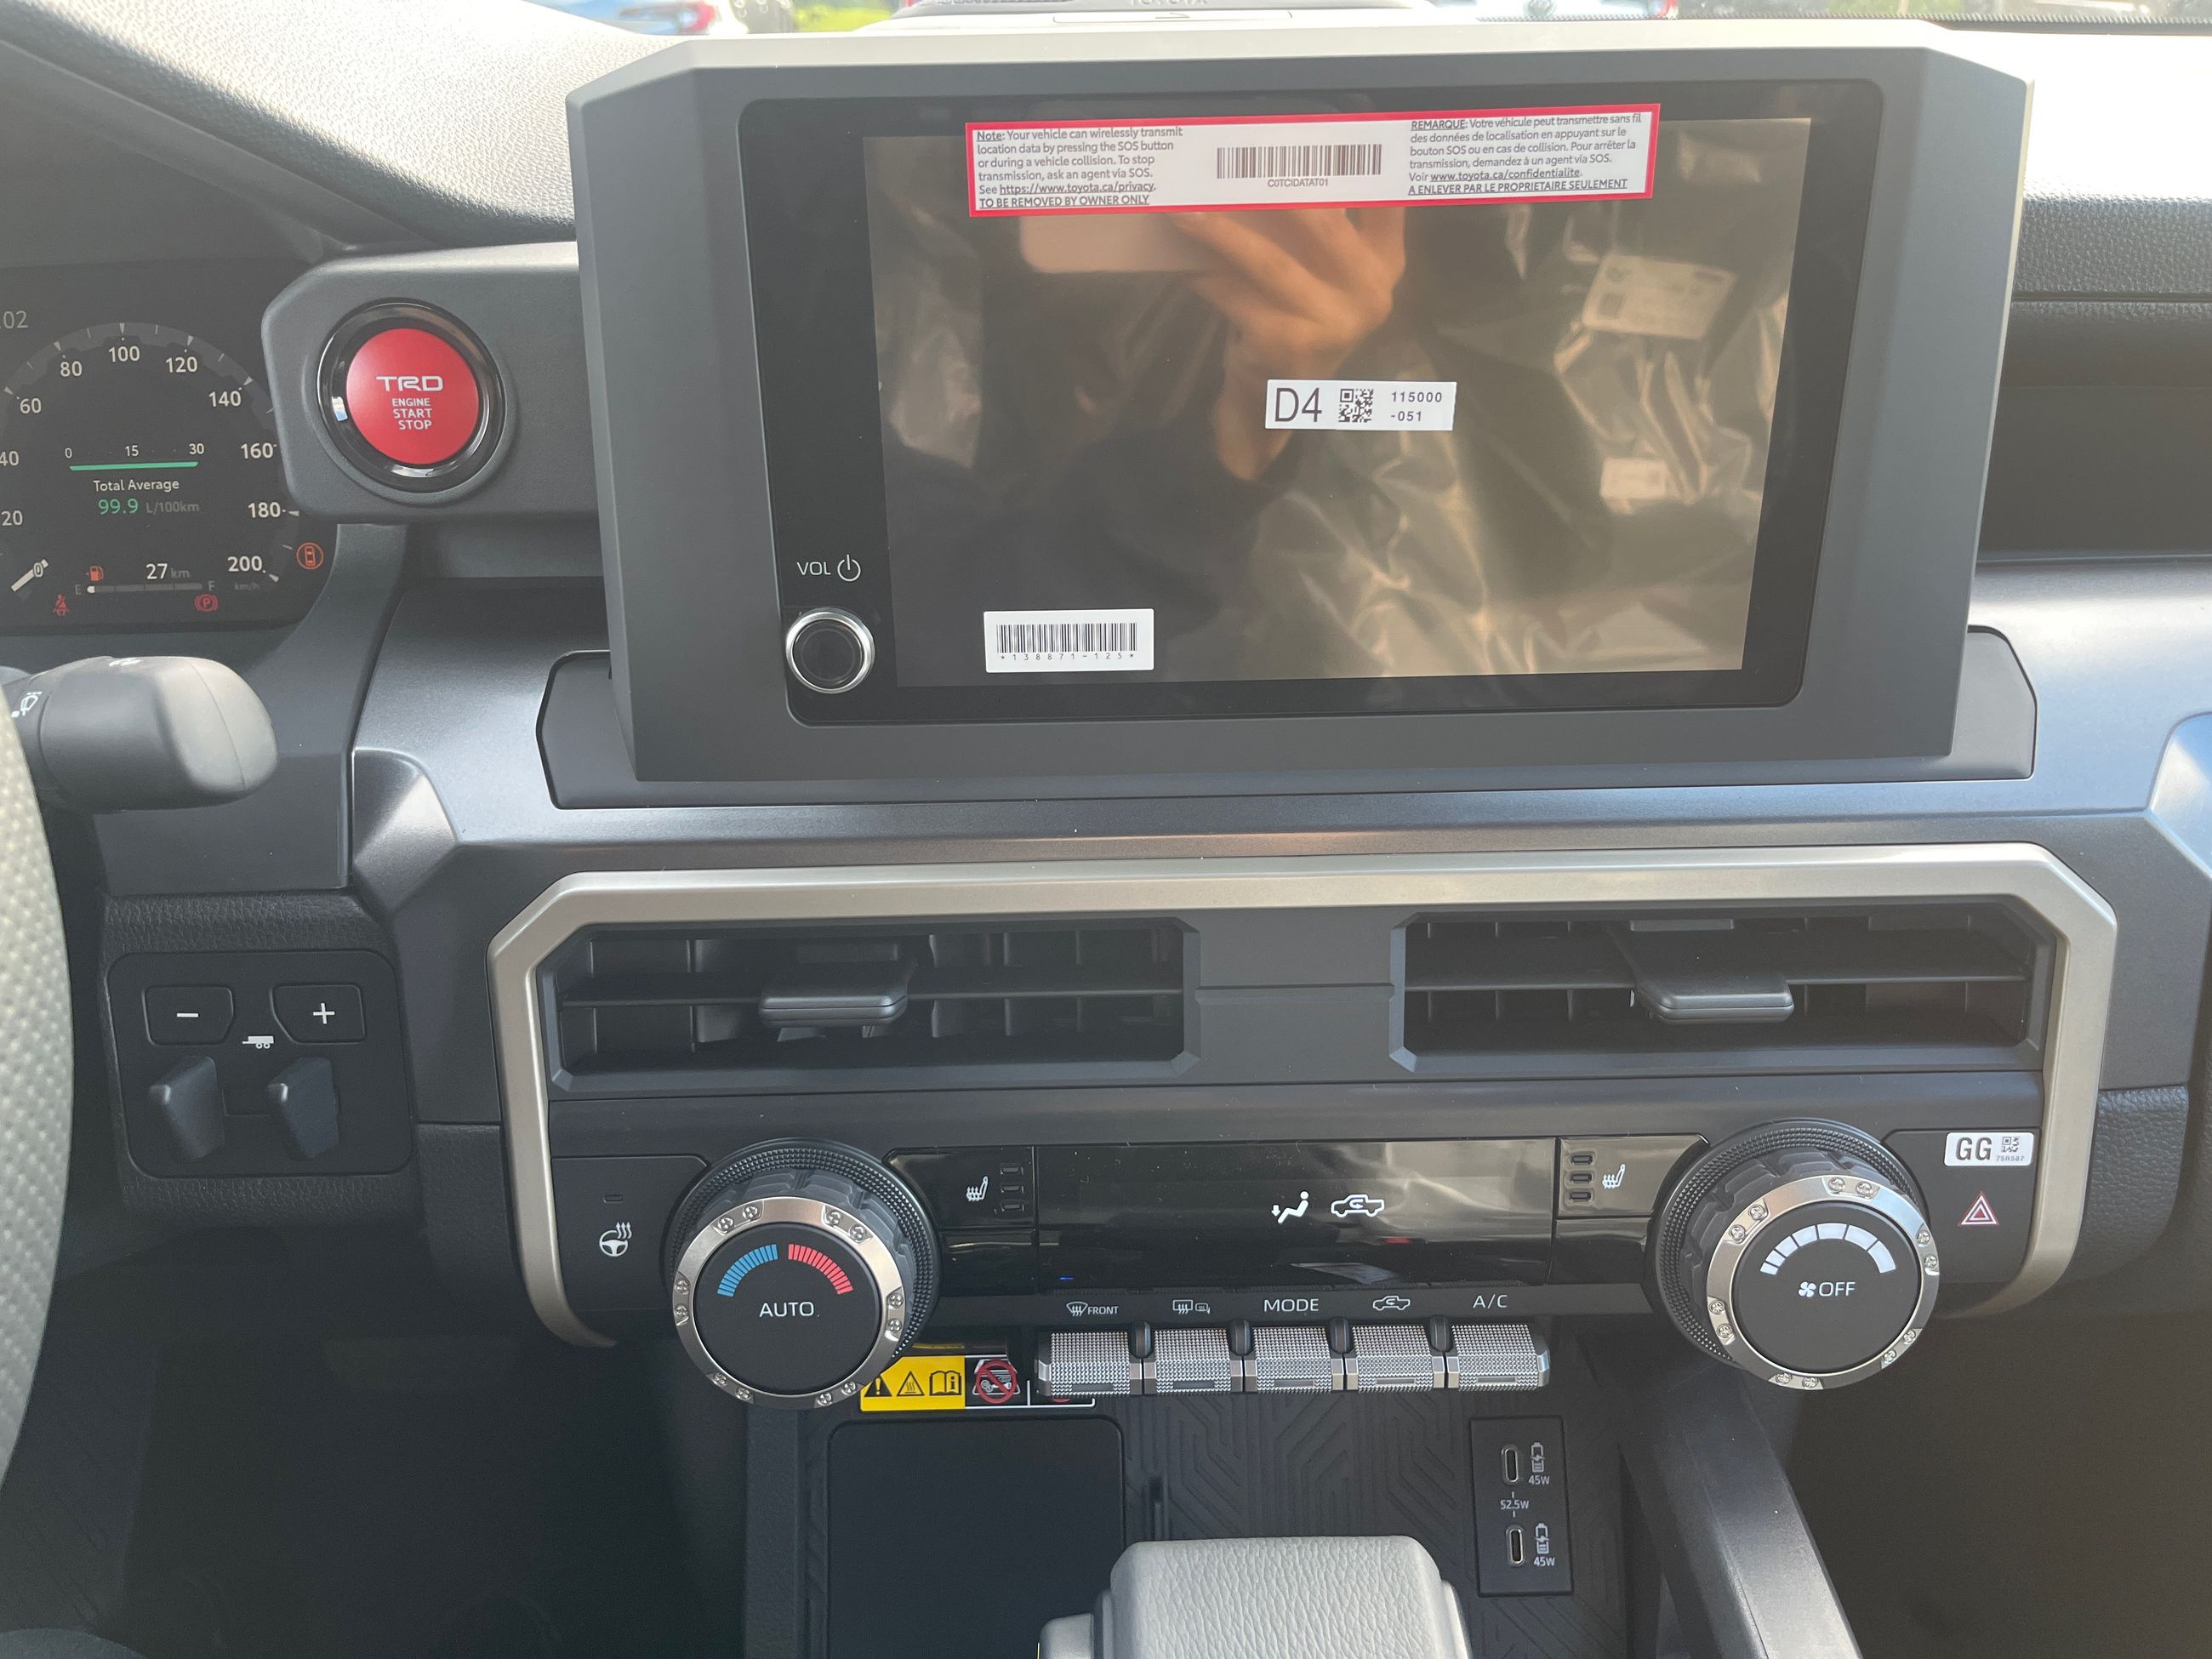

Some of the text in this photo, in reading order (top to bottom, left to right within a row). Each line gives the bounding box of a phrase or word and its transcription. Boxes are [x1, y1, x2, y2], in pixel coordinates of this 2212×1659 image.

[1411, 113, 1641, 131] REMARQUE: Votre véhicule peut transmettre sans fil
[977, 126, 1183, 141] Note: Your vehicle can wirelessly transmit
[1411, 134, 1428, 143] des
[1429, 132, 1470, 142] données
[1472, 131, 1484, 141] de
[1486, 130, 1539, 140] localisation
[1555, 129, 1599, 140] appuyant
[1617, 127, 1627, 136] le
[978, 140, 1173, 155] location data by pressing the SOS button
[1410, 146, 1445, 156] bouton
[1446, 145, 1466, 155] SOS
[1514, 143, 1525, 153] de
[1527, 142, 1569, 152] collision.
[1571, 142, 1592, 151] Pour
[1593, 140, 1625, 150] arrêter
[1627, 140, 1636, 149] la
[990, 157, 1023, 168] during
[1035, 157, 1069, 167] vehicle
[1072, 155, 1116, 165] collision.
[1118, 155, 1130, 164] To
[1132, 155, 1154, 166] stop
[1410, 158, 1470, 169] transmission,
[1472, 157, 1521, 167] demandez
[1524, 157, 1530, 165] à
[1545, 156, 1572, 166] agent
[1575, 155, 1588, 163] via
[1589, 154, 1612, 163] SOS.
[978, 170, 1045, 181] transmission,
[1047, 169, 1063, 180] ask
[1080, 170, 1110, 180] agent
[1112, 168, 1126, 178] via
[1129, 168, 1153, 178] SOS.
[1409, 168, 1582, 182] Voir www.toyota.ca/confidentialite.
[979, 181, 1156, 195] See https://www.toyota.ca/privacy.
[1408, 179, 1627, 196] A ENLEVER PAR LE PROPRIETAIRE SEULEMENT
[980, 195, 1149, 208] TO BE REMOVED BY OWNER ONLY
[0, 311, 28, 328] 02
[108, 345, 140, 362] 100
[60, 361, 83, 377] 80
[165, 356, 198, 374] 120
[376, 376, 443, 391] TRD
[208, 390, 242, 408] 140
[391, 398, 430, 407] ENGINE
[1392, 391, 1442, 402] 115000
[20, 397, 42, 414] 60
[1274, 387, 1322, 422] D4
[393, 408, 432, 419] START
[1390, 411, 1422, 422] -051
[398, 419, 432, 430] STOP
[65, 448, 73, 459] 0
[125, 446, 139, 457] 15
[189, 442, 205, 455] 30
[240, 442, 274, 459] 160
[0, 451, 19, 466] 40
[94, 478, 180, 493] Total Average
[98, 498, 200, 516] 99.9 L/100km
[248, 502, 281, 518] 180
[1, 510, 23, 526] 20
[34, 562, 43, 578] 0
[146, 563, 190, 579] 27 km
[227, 556, 263, 573] 200
[796, 562, 831, 575] VOL
[75, 584, 82, 595] E
[208, 581, 214, 591] F
[1955, 1137, 1993, 1160] GG
[1818, 1281, 1856, 1297] OFF
[759, 1301, 814, 1317] AUTO
[1264, 1297, 1320, 1312] MODE
[1473, 1294, 1508, 1309] A/C
[1087, 1306, 1119, 1315] FRONT
[1529, 1475, 1550, 1485] 45W
[1500, 1500, 1530, 1510] 52.5W
[1534, 1557, 1555, 1567] 45W
